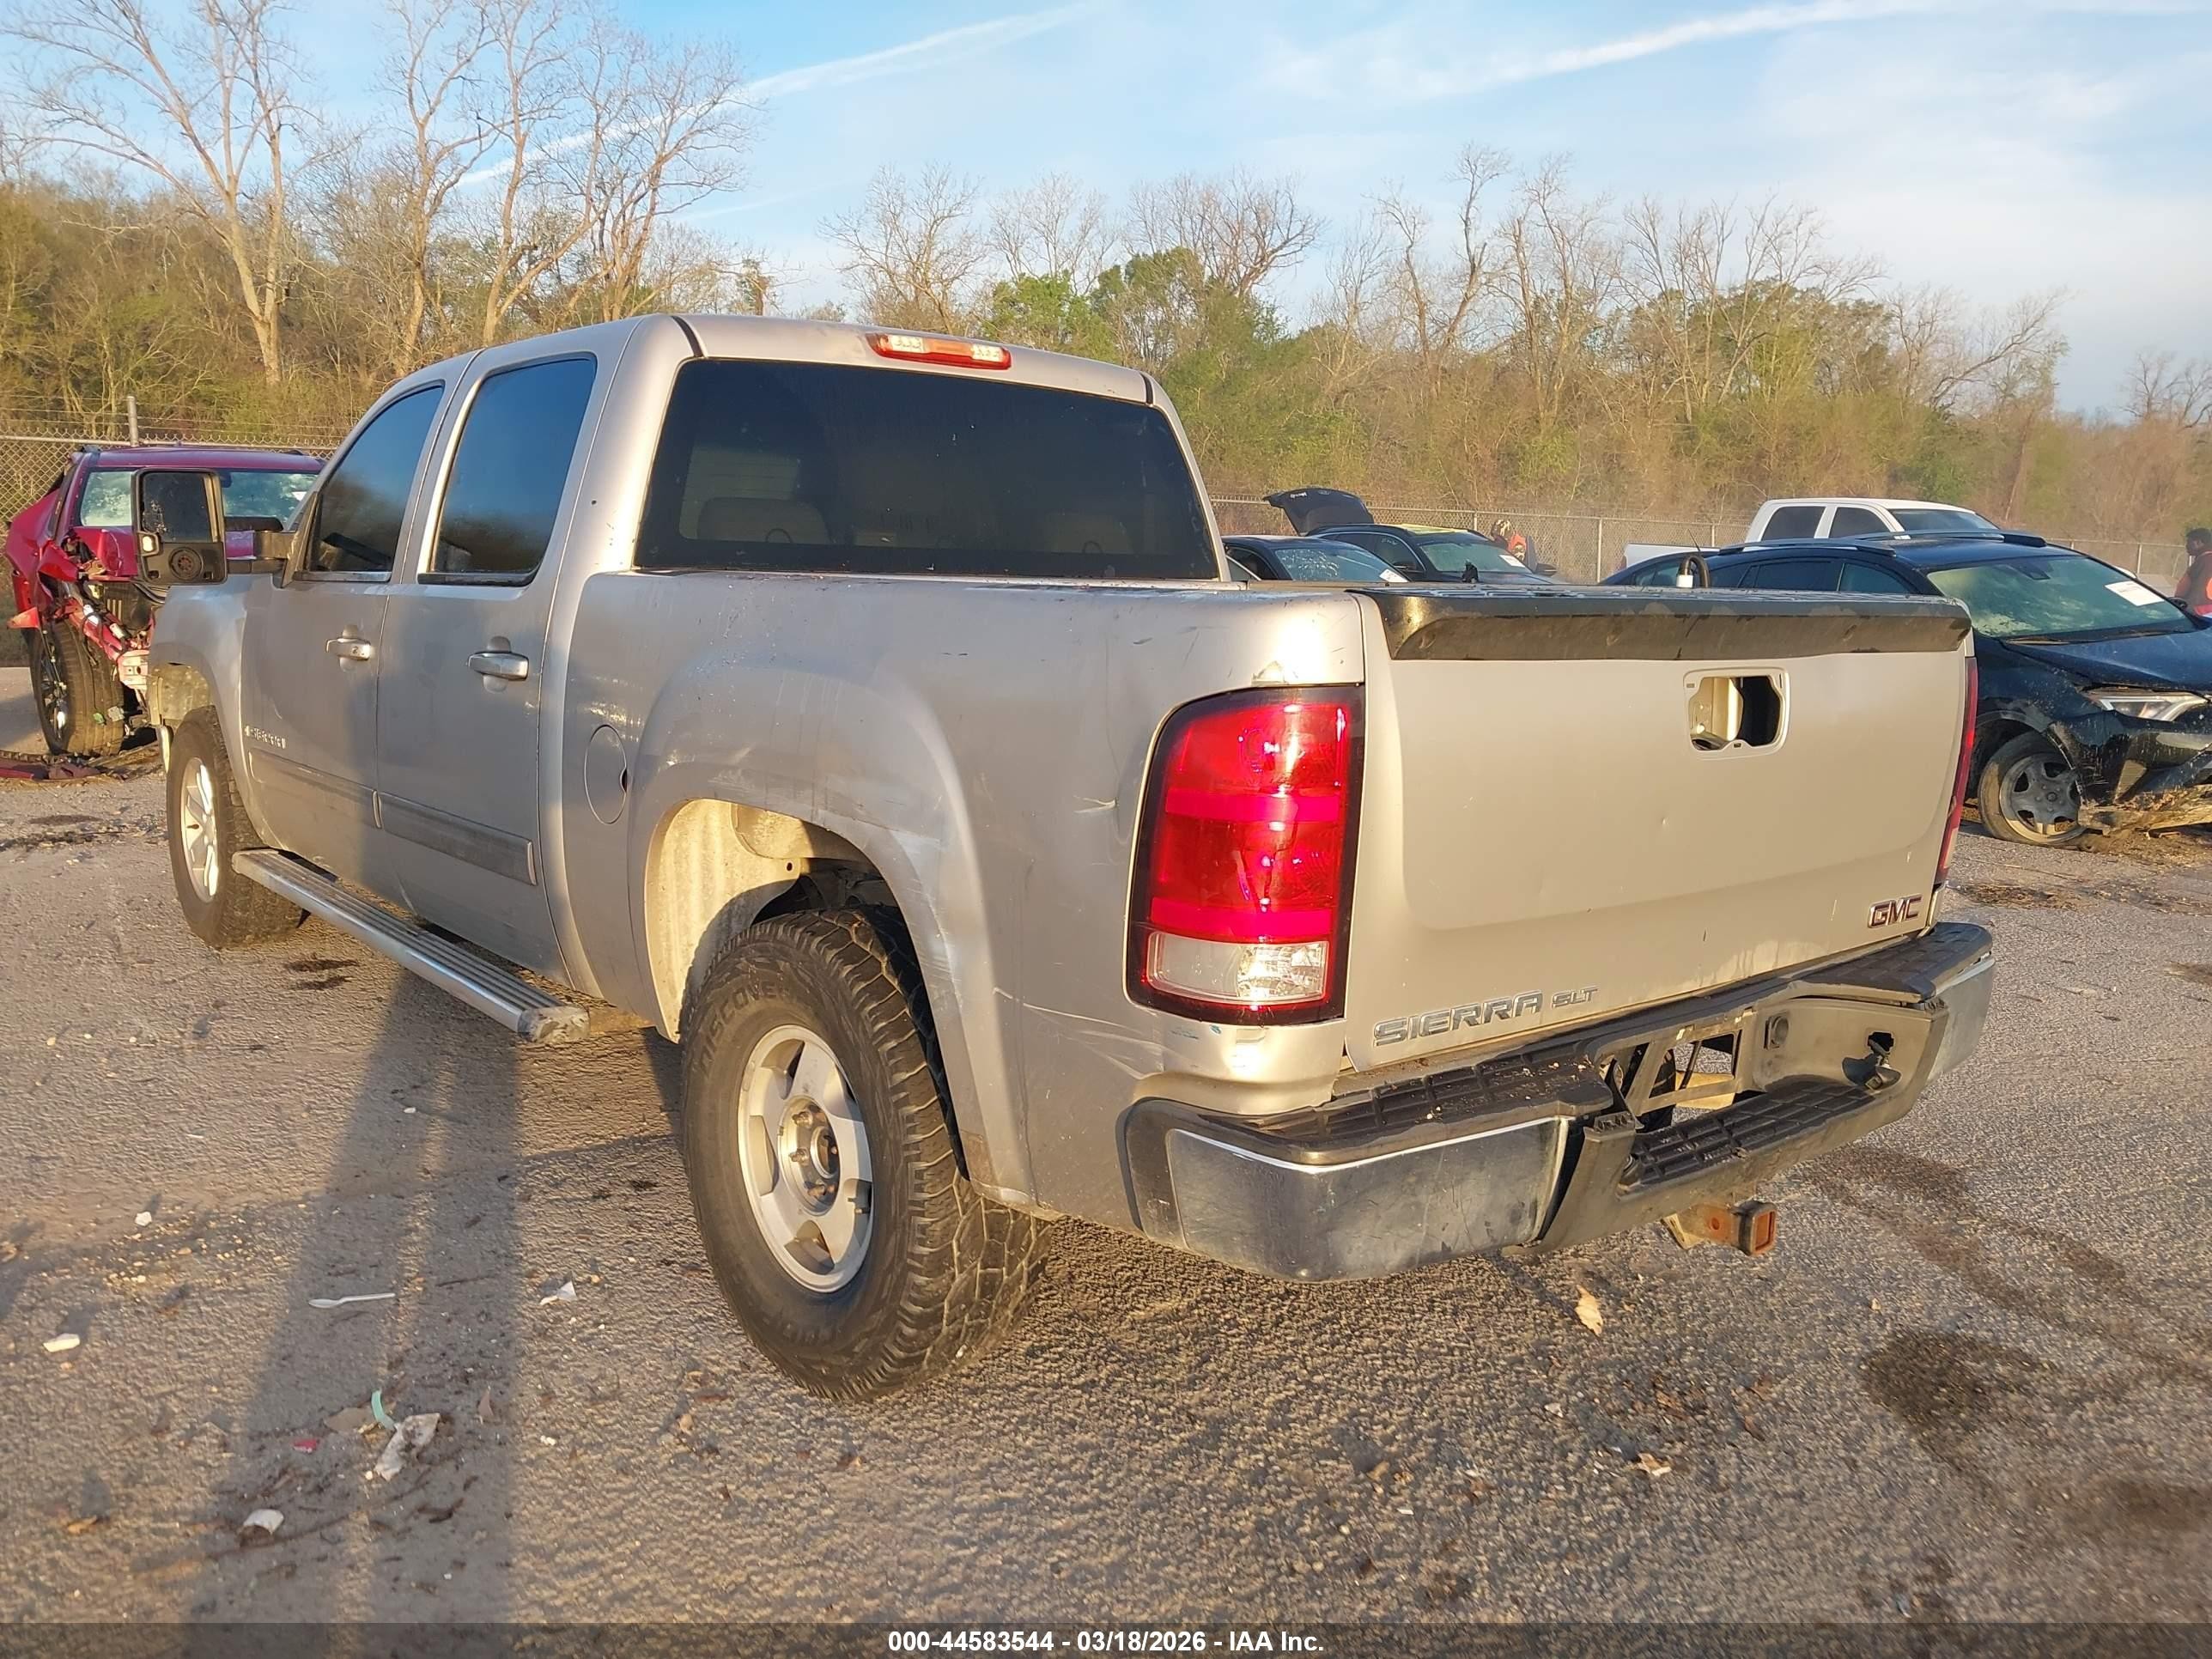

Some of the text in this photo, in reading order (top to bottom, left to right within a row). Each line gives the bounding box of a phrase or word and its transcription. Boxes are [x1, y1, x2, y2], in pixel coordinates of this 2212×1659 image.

[1868, 894, 1923, 928] GMC
[1374, 986, 1598, 1048] SIERRA SLT
